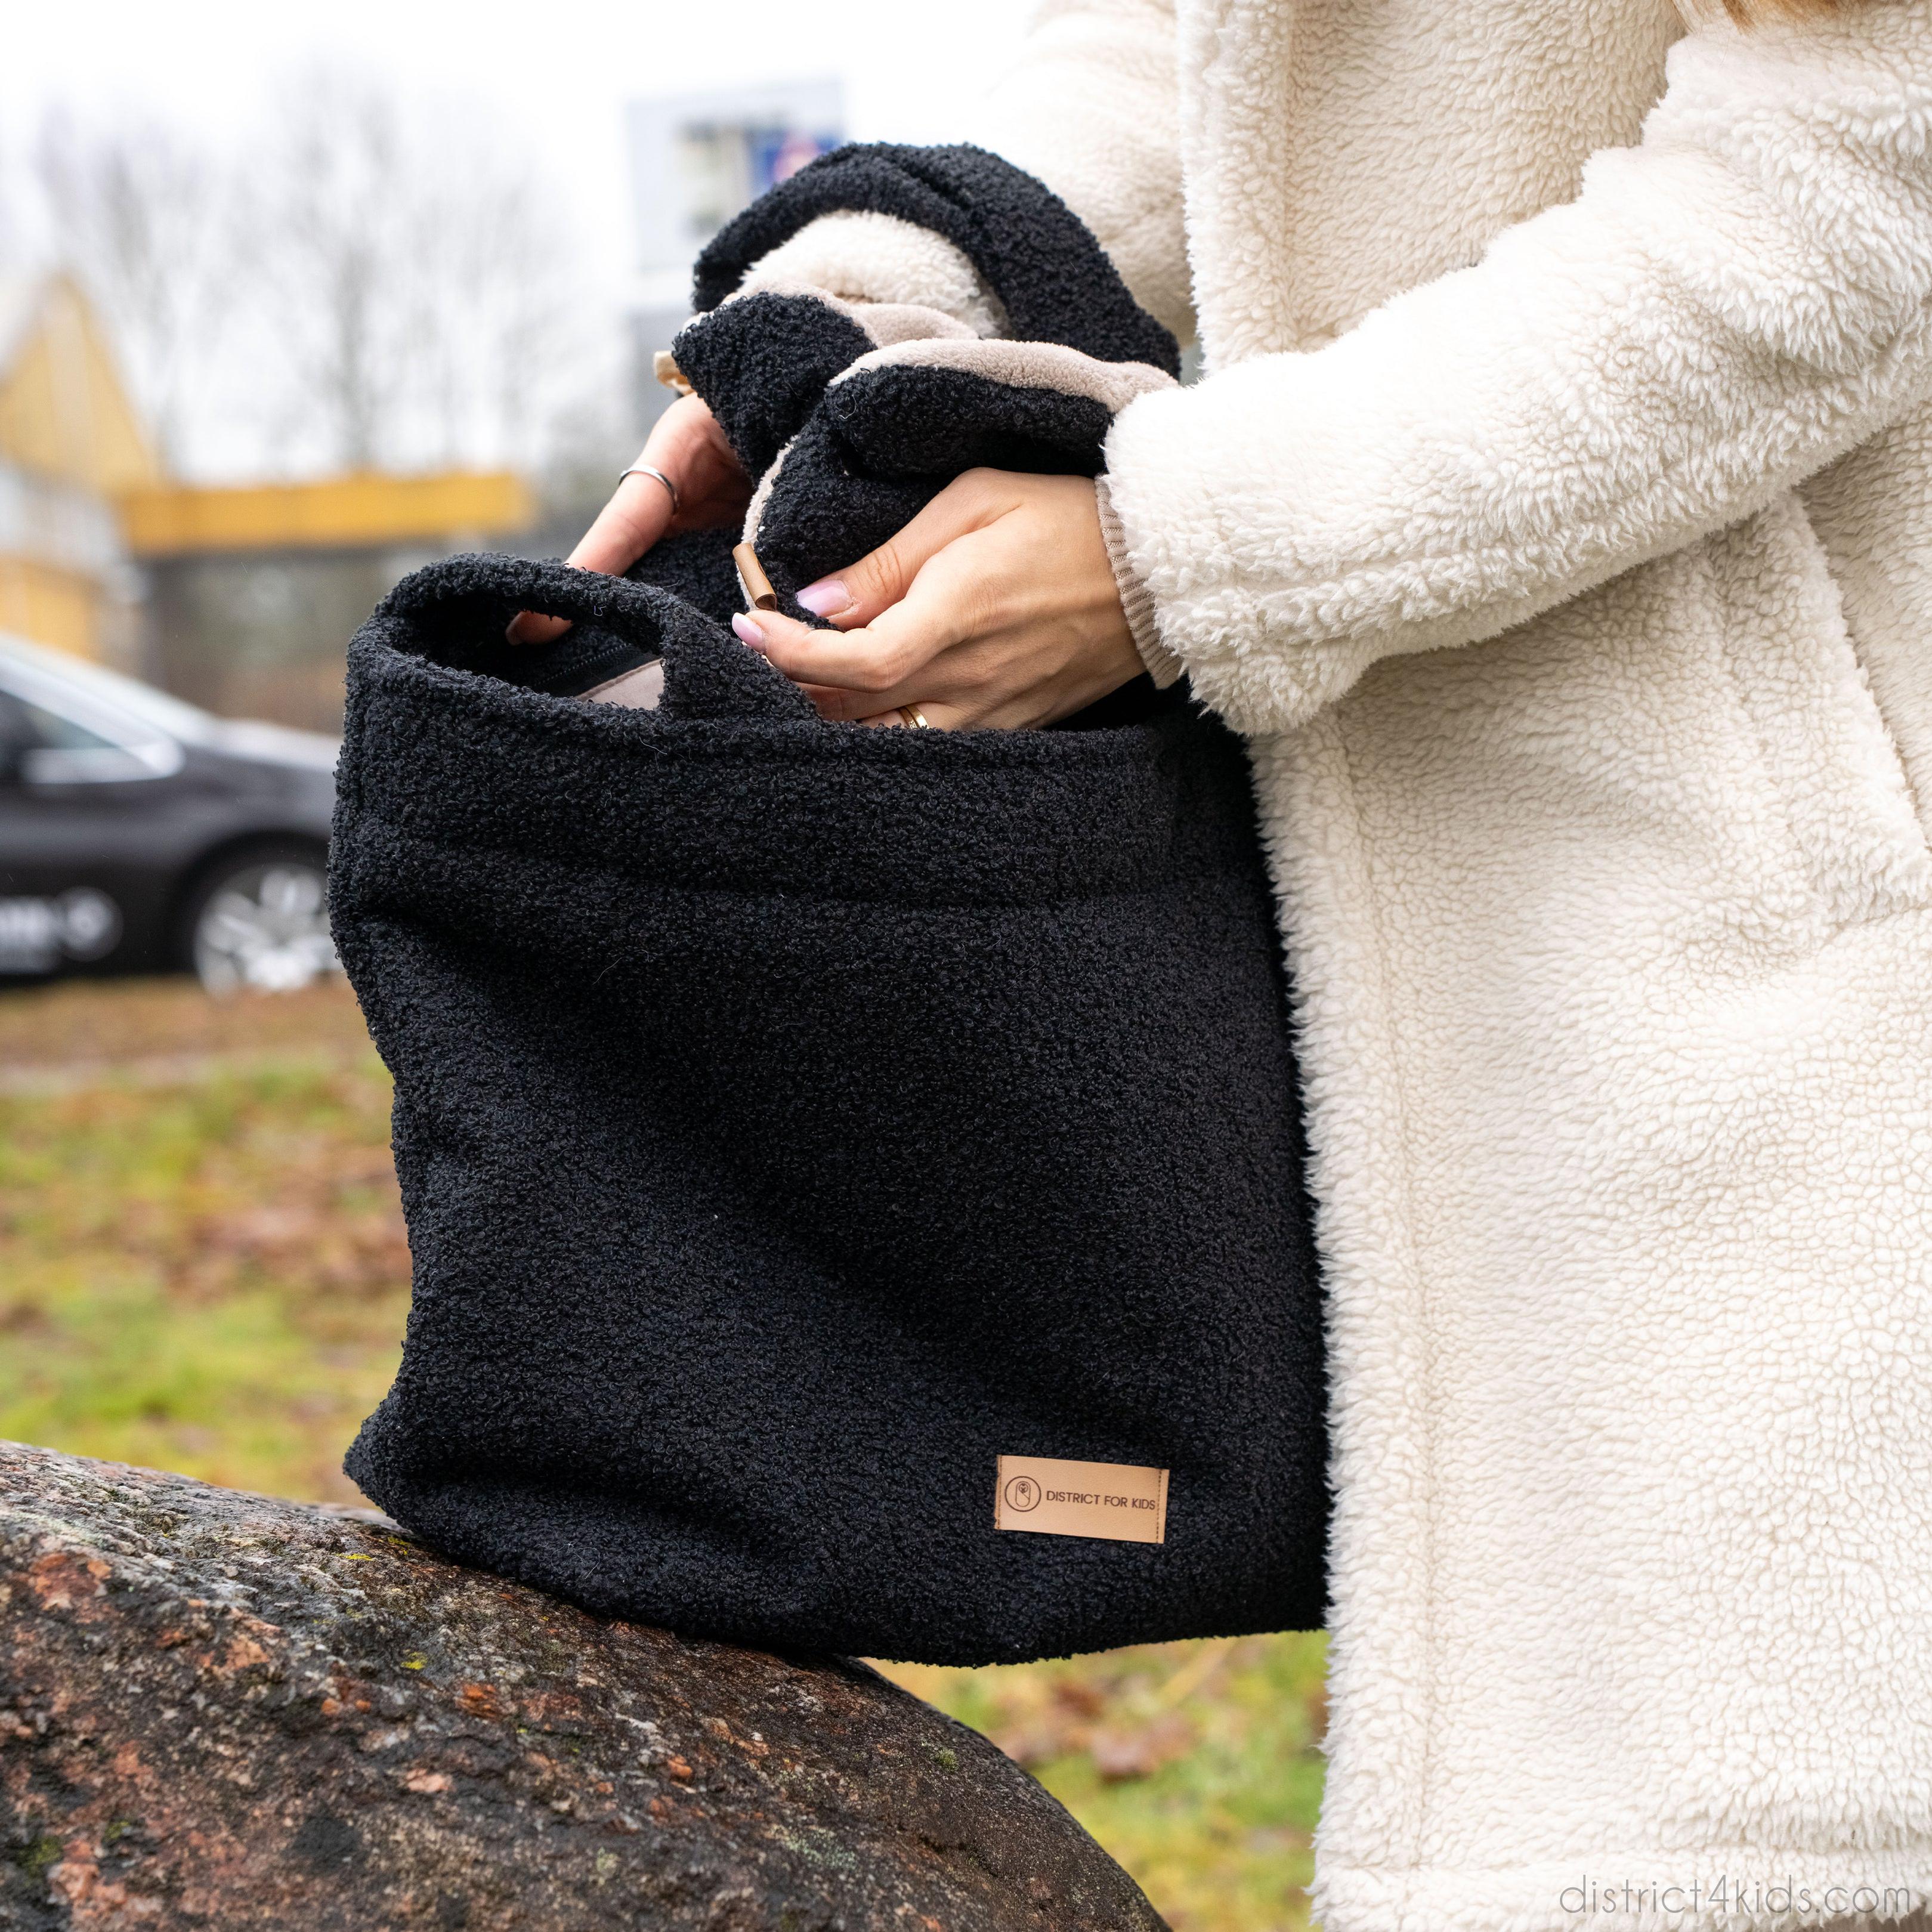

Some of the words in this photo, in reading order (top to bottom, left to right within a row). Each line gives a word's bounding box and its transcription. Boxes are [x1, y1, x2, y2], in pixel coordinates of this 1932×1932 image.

[1046, 1491, 1101, 1505] DISTRICT
[1104, 1495, 1128, 1507] FOR
[1132, 1498, 1156, 1510] KIDS
